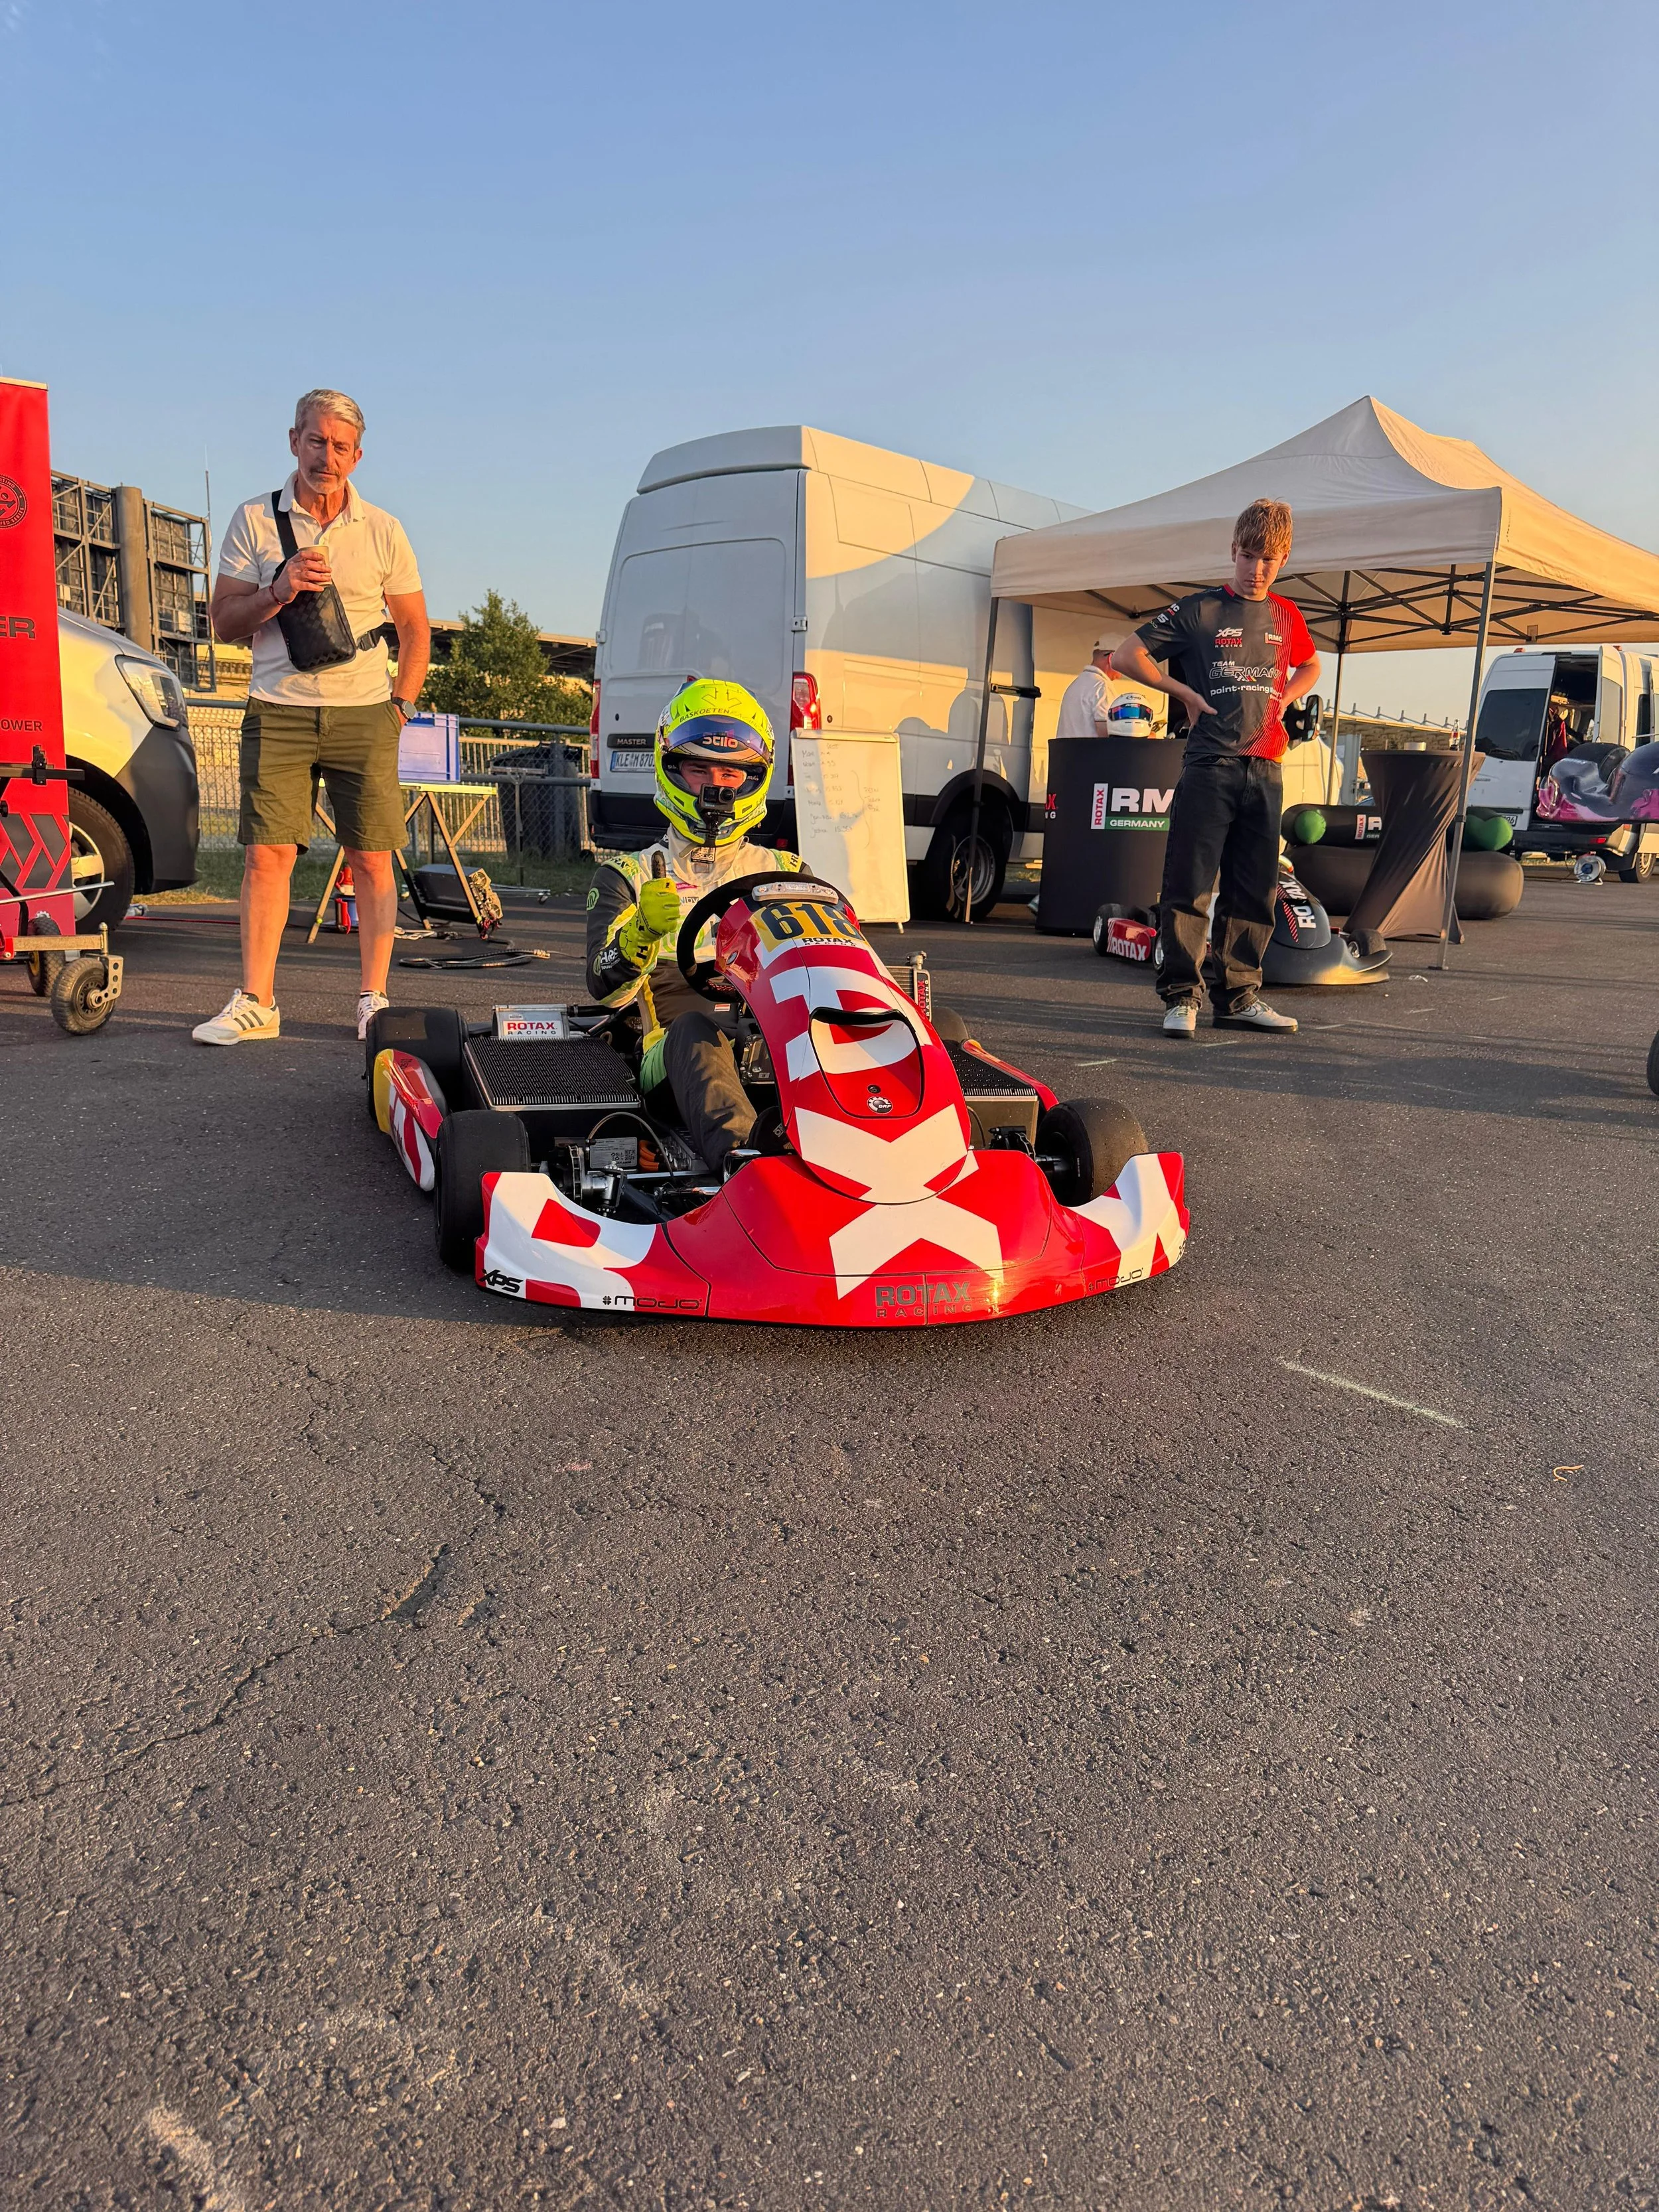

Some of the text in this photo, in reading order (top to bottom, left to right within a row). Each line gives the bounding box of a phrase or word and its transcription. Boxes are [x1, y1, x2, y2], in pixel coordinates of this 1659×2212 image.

[0, 616, 36, 639] R
[1215, 627, 1244, 638] XPS
[1268, 634, 1283, 642] RMC
[1209, 666, 1282, 680] GERMANY
[1210, 684, 1270, 697] point-racing
[679, 708, 730, 723] BASKOETEN
[616, 754, 629, 767] KLE
[639, 755, 655, 767] 870
[1045, 793, 1057, 810] X
[1094, 788, 1105, 825] ROTAX
[1110, 819, 1165, 828] GERMANY
[1278, 881, 1317, 928] ROAX
[760, 903, 866, 941] 618
[1110, 936, 1147, 962] ROTAX
[506, 1022, 555, 1031] ROTAX
[478, 1269, 524, 1293] XPS
[876, 1282, 971, 1307] ROTAX
[876, 1303, 972, 1318] RACING
